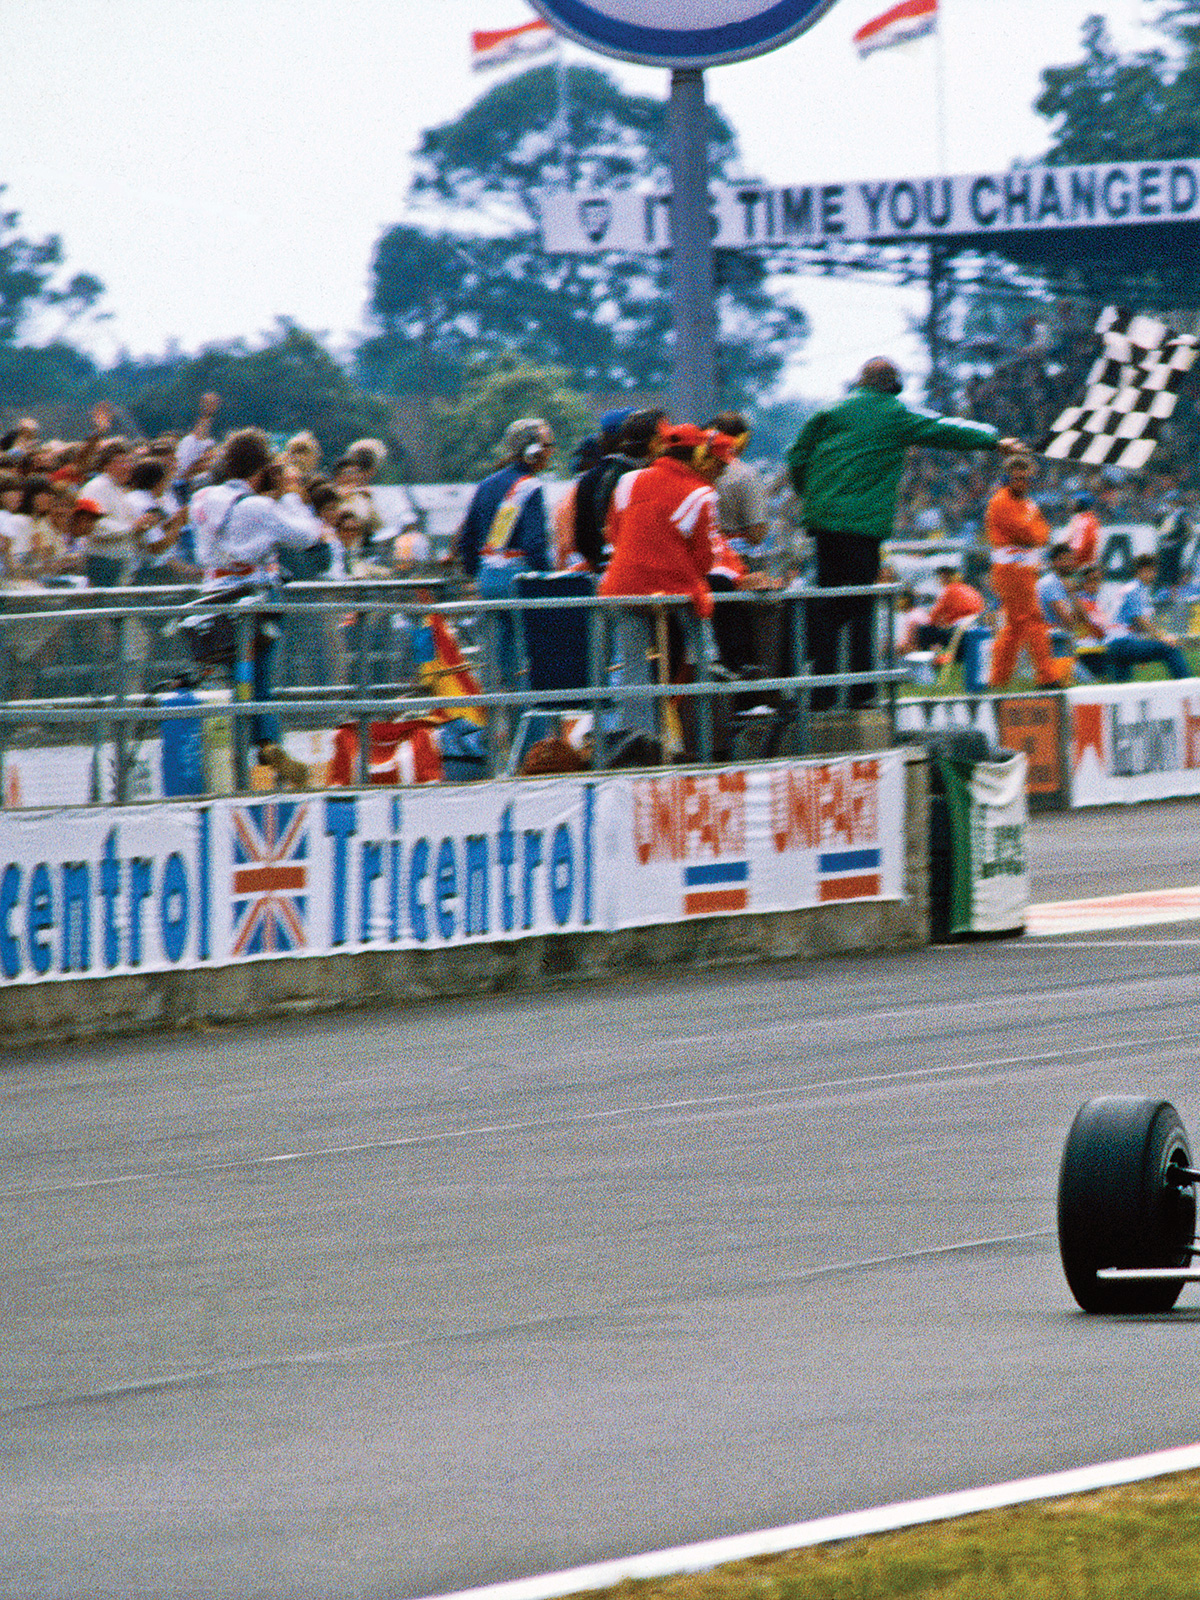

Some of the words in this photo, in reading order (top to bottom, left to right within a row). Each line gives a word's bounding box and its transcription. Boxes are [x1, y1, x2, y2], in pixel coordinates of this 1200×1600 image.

[737, 185, 845, 238] TIME
[860, 179, 952, 232] YOU
[968, 163, 1200, 227] CHANGED
[324, 784, 594, 947] Tricentrol
